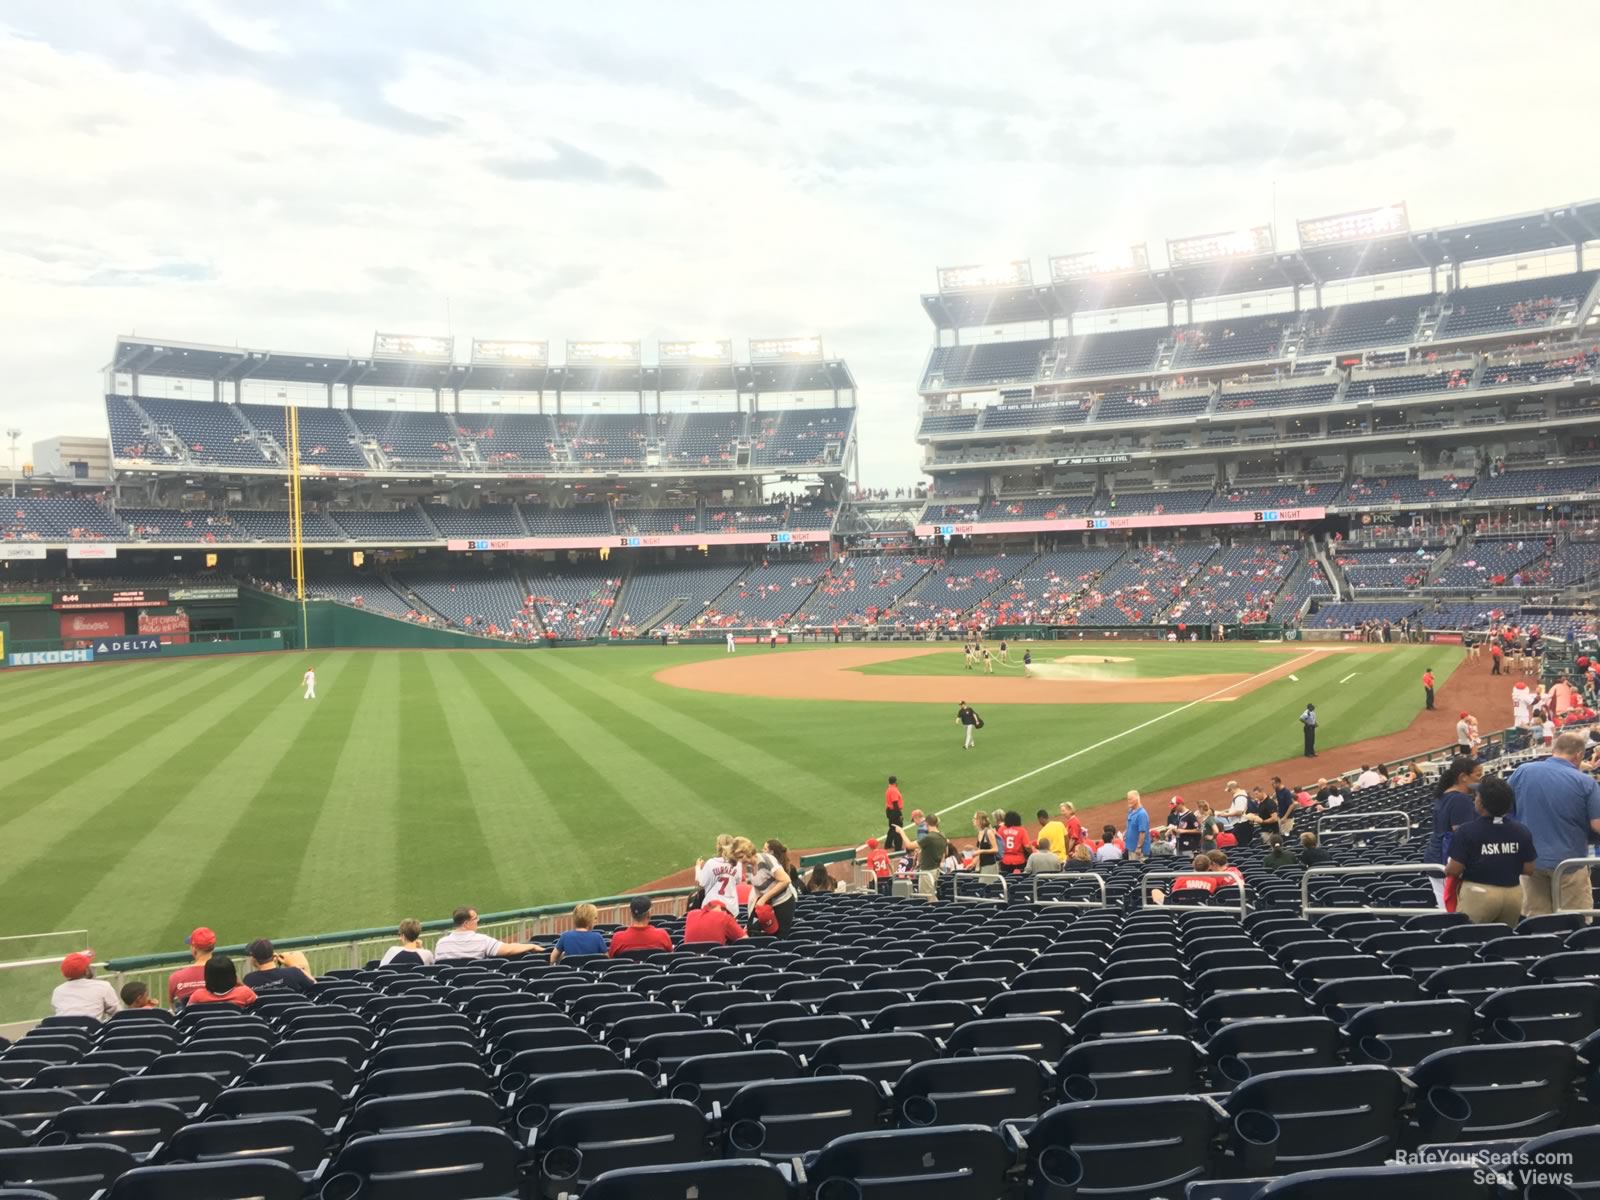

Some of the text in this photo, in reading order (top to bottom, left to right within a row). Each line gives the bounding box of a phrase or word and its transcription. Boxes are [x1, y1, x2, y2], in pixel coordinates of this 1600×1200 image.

[1280, 510, 1301, 519] NIGHT
[1373, 514, 1395, 523] PNC
[1110, 518, 1130, 527] NIGHT
[955, 525, 973, 534] NIGHT
[643, 537, 661, 545] NIGHT
[792, 533, 810, 541] NIGHT
[112, 640, 158, 651] DELTA
[30, 650, 88, 666] KOCH
[1006, 836, 1014, 849] 6
[1481, 842, 1519, 855] ASK ME!
[874, 859, 887, 871] 34
[718, 877, 729, 895] 7
